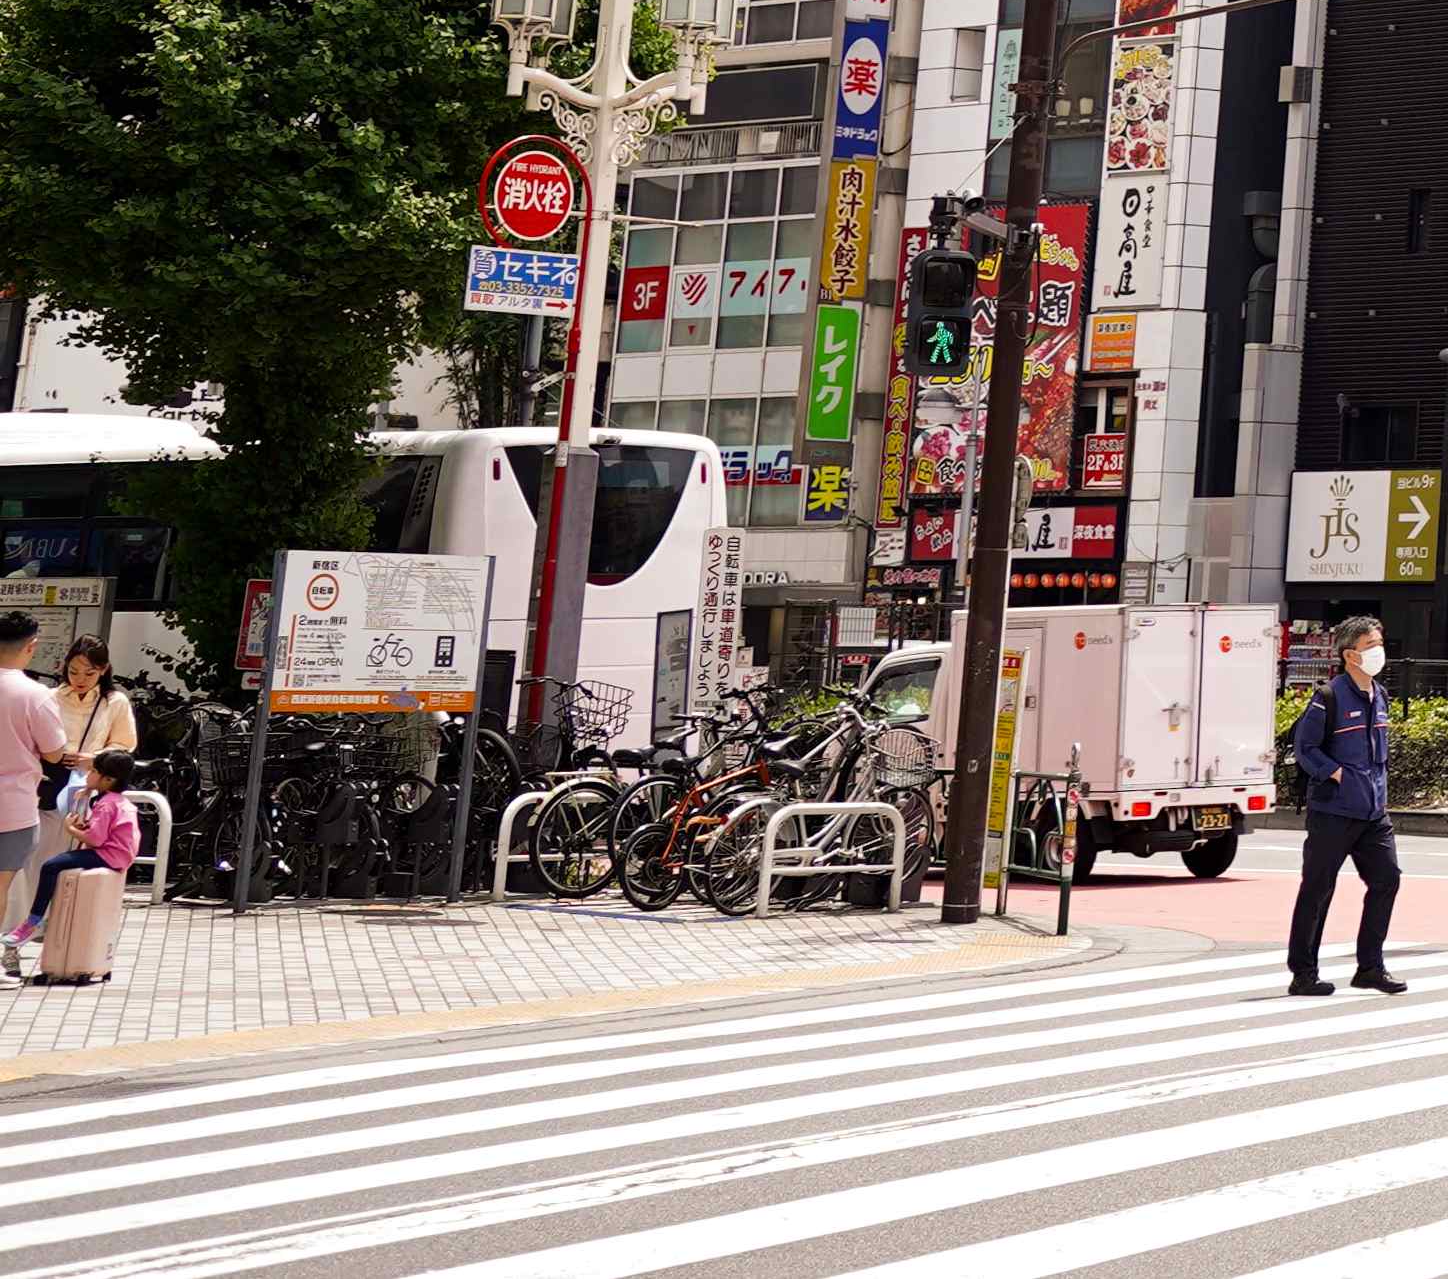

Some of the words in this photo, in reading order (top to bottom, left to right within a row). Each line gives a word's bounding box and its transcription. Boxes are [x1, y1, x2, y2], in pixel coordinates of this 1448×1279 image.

[846, 58, 880, 96] 薬
[512, 162, 528, 173] FIRE
[530, 165, 564, 176] HYDRANT
[503, 177, 568, 214] 消火栓
[831, 165, 866, 300] 肉汁水餃子
[1114, 188, 1141, 299] 日高屋
[500, 254, 576, 285] セキネ
[633, 281, 659, 311] 3F
[818, 325, 848, 415] レイク
[1026, 514, 1055, 551] 屋
[1308, 563, 1363, 577] SHINJUKU
[1399, 562, 1423, 576] 60m
[697, 535, 723, 698] ゆっくり通行しましょう
[716, 536, 740, 693] 自転車は車道寄りを
[317, 658, 343, 667] OPEN
